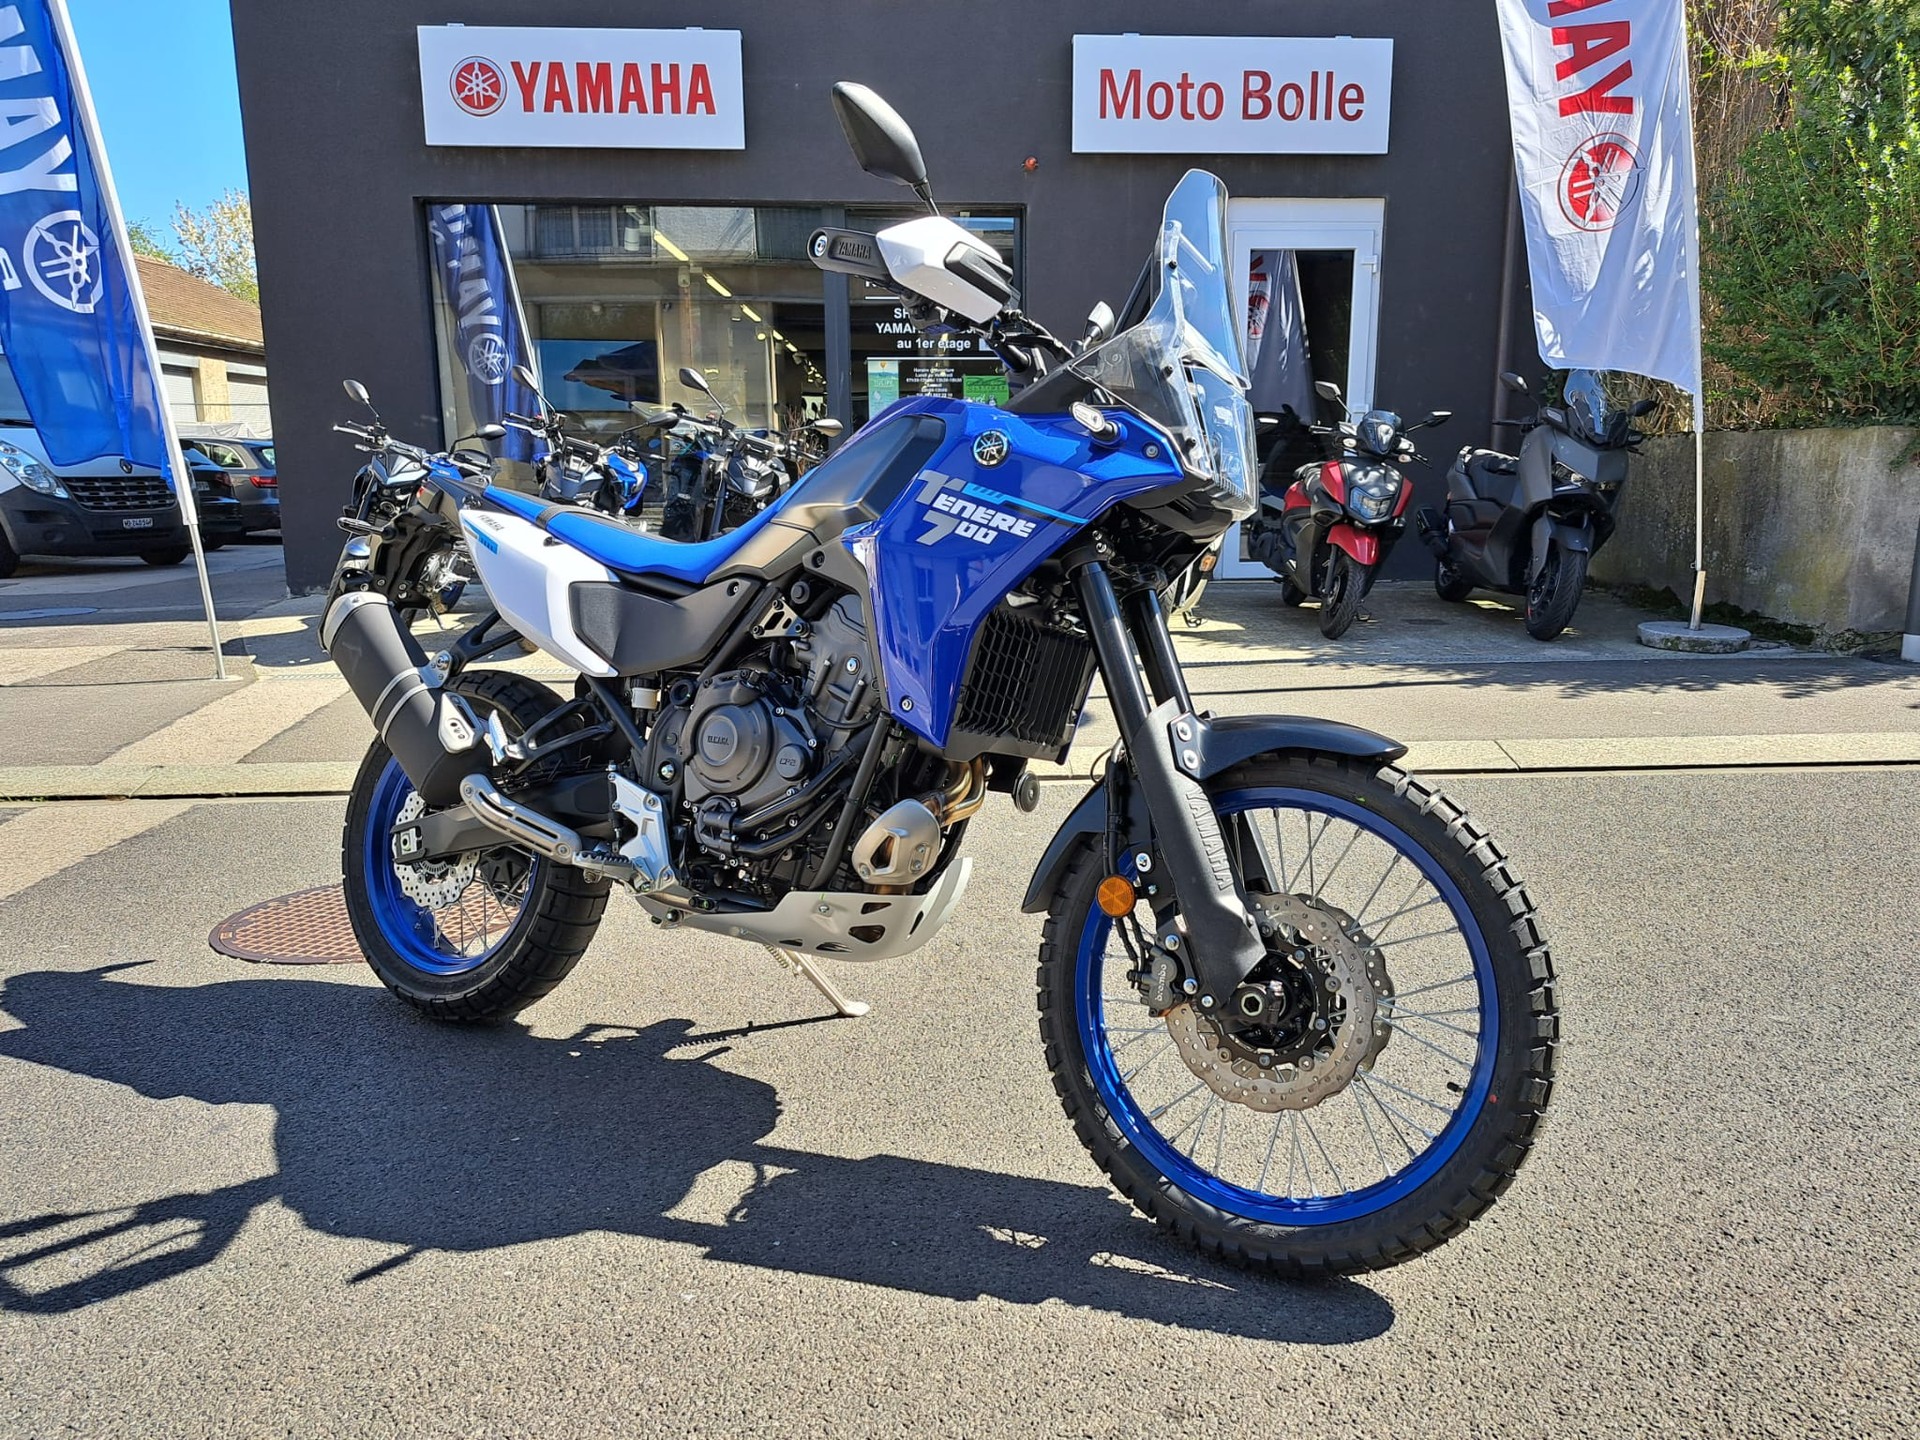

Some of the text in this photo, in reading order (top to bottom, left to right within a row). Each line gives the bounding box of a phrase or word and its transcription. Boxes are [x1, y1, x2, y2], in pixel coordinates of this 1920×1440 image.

[510, 61, 717, 115] YAMAHA
[1099, 68, 1365, 122] Moto Bolle
[839, 241, 871, 260] YAMAHA
[893, 307, 911, 319] SH
[897, 340, 912, 349] au
[915, 338, 935, 349] 1er
[915, 509, 999, 546] 700
[779, 758, 796, 767] CP2
[1186, 785, 1234, 891] YAMAHA
[1154, 963, 1167, 1002] brembo
